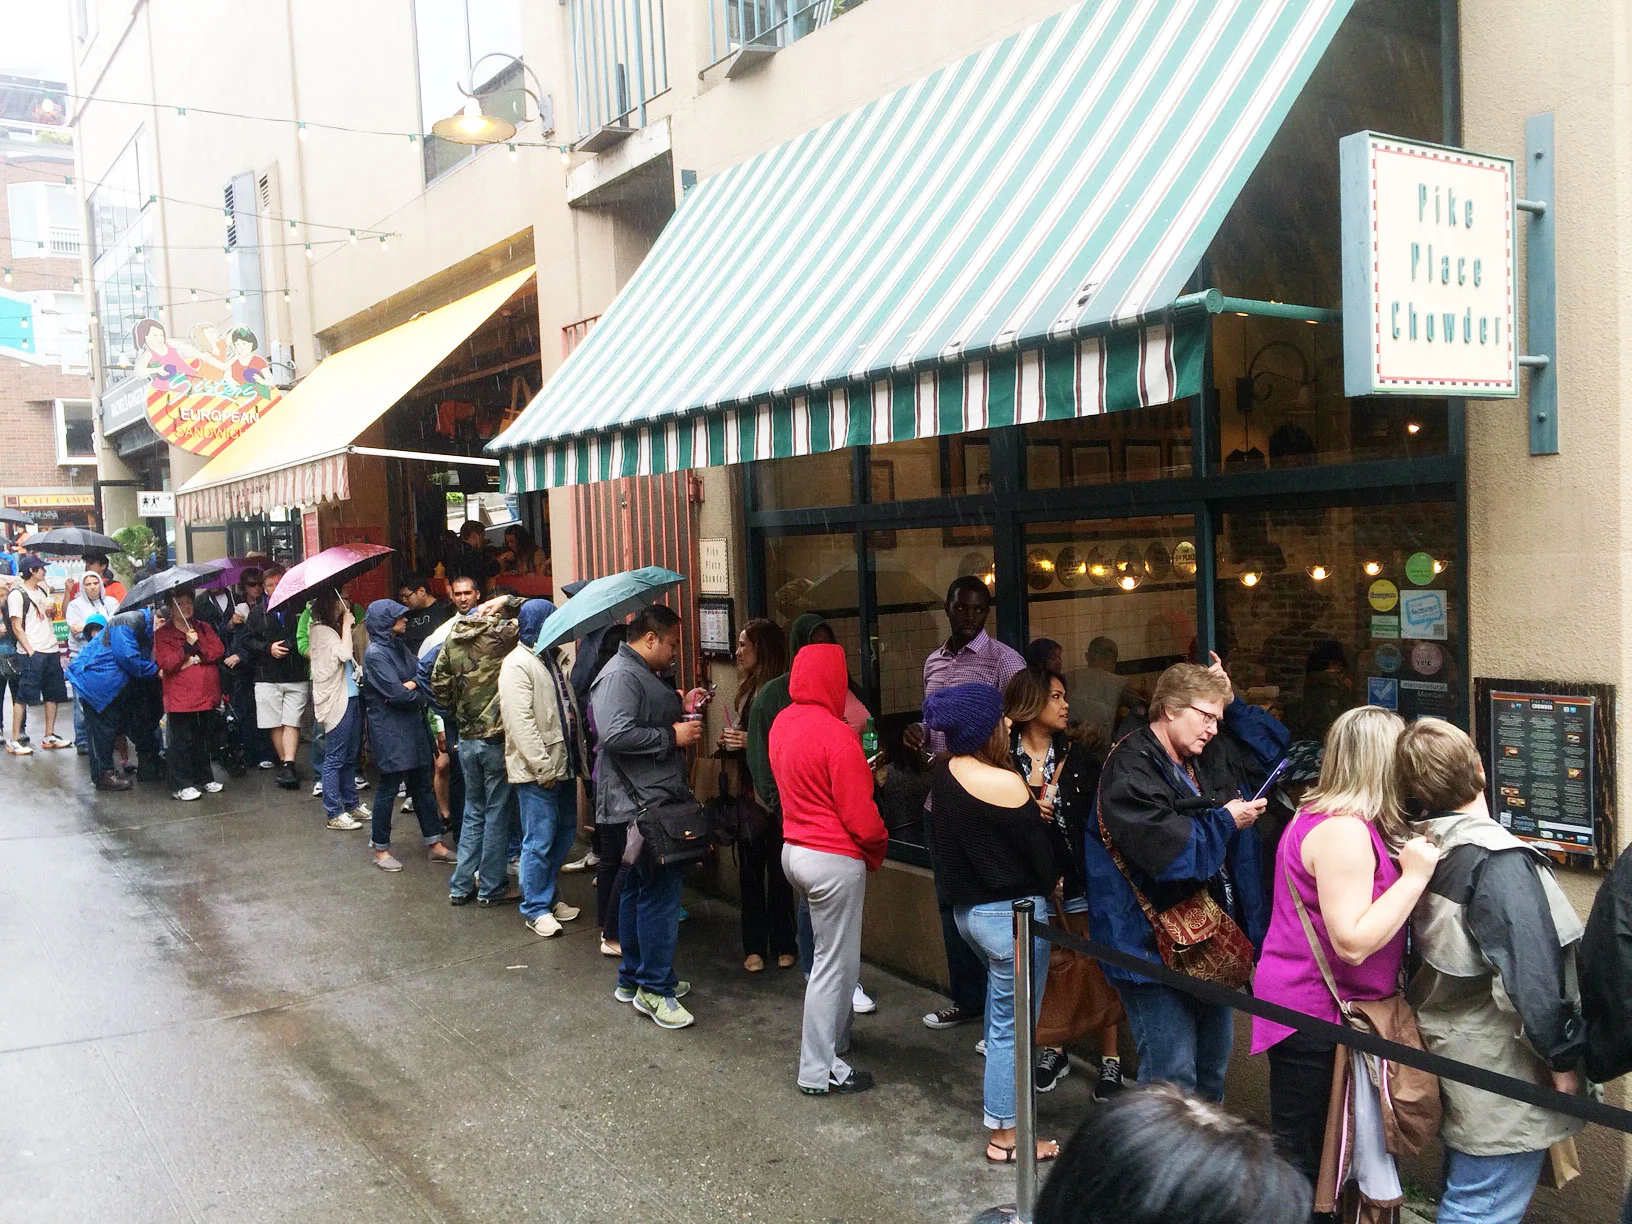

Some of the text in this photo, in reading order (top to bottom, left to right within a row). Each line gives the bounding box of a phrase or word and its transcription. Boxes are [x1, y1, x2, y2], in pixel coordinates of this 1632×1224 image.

[1418, 182, 1473, 229] Pike
[1411, 242, 1482, 288] Place
[1391, 300, 1502, 346] Chowder
[180, 407, 260, 425] EUROPEAN
[1416, 659, 1432, 667] yelp
